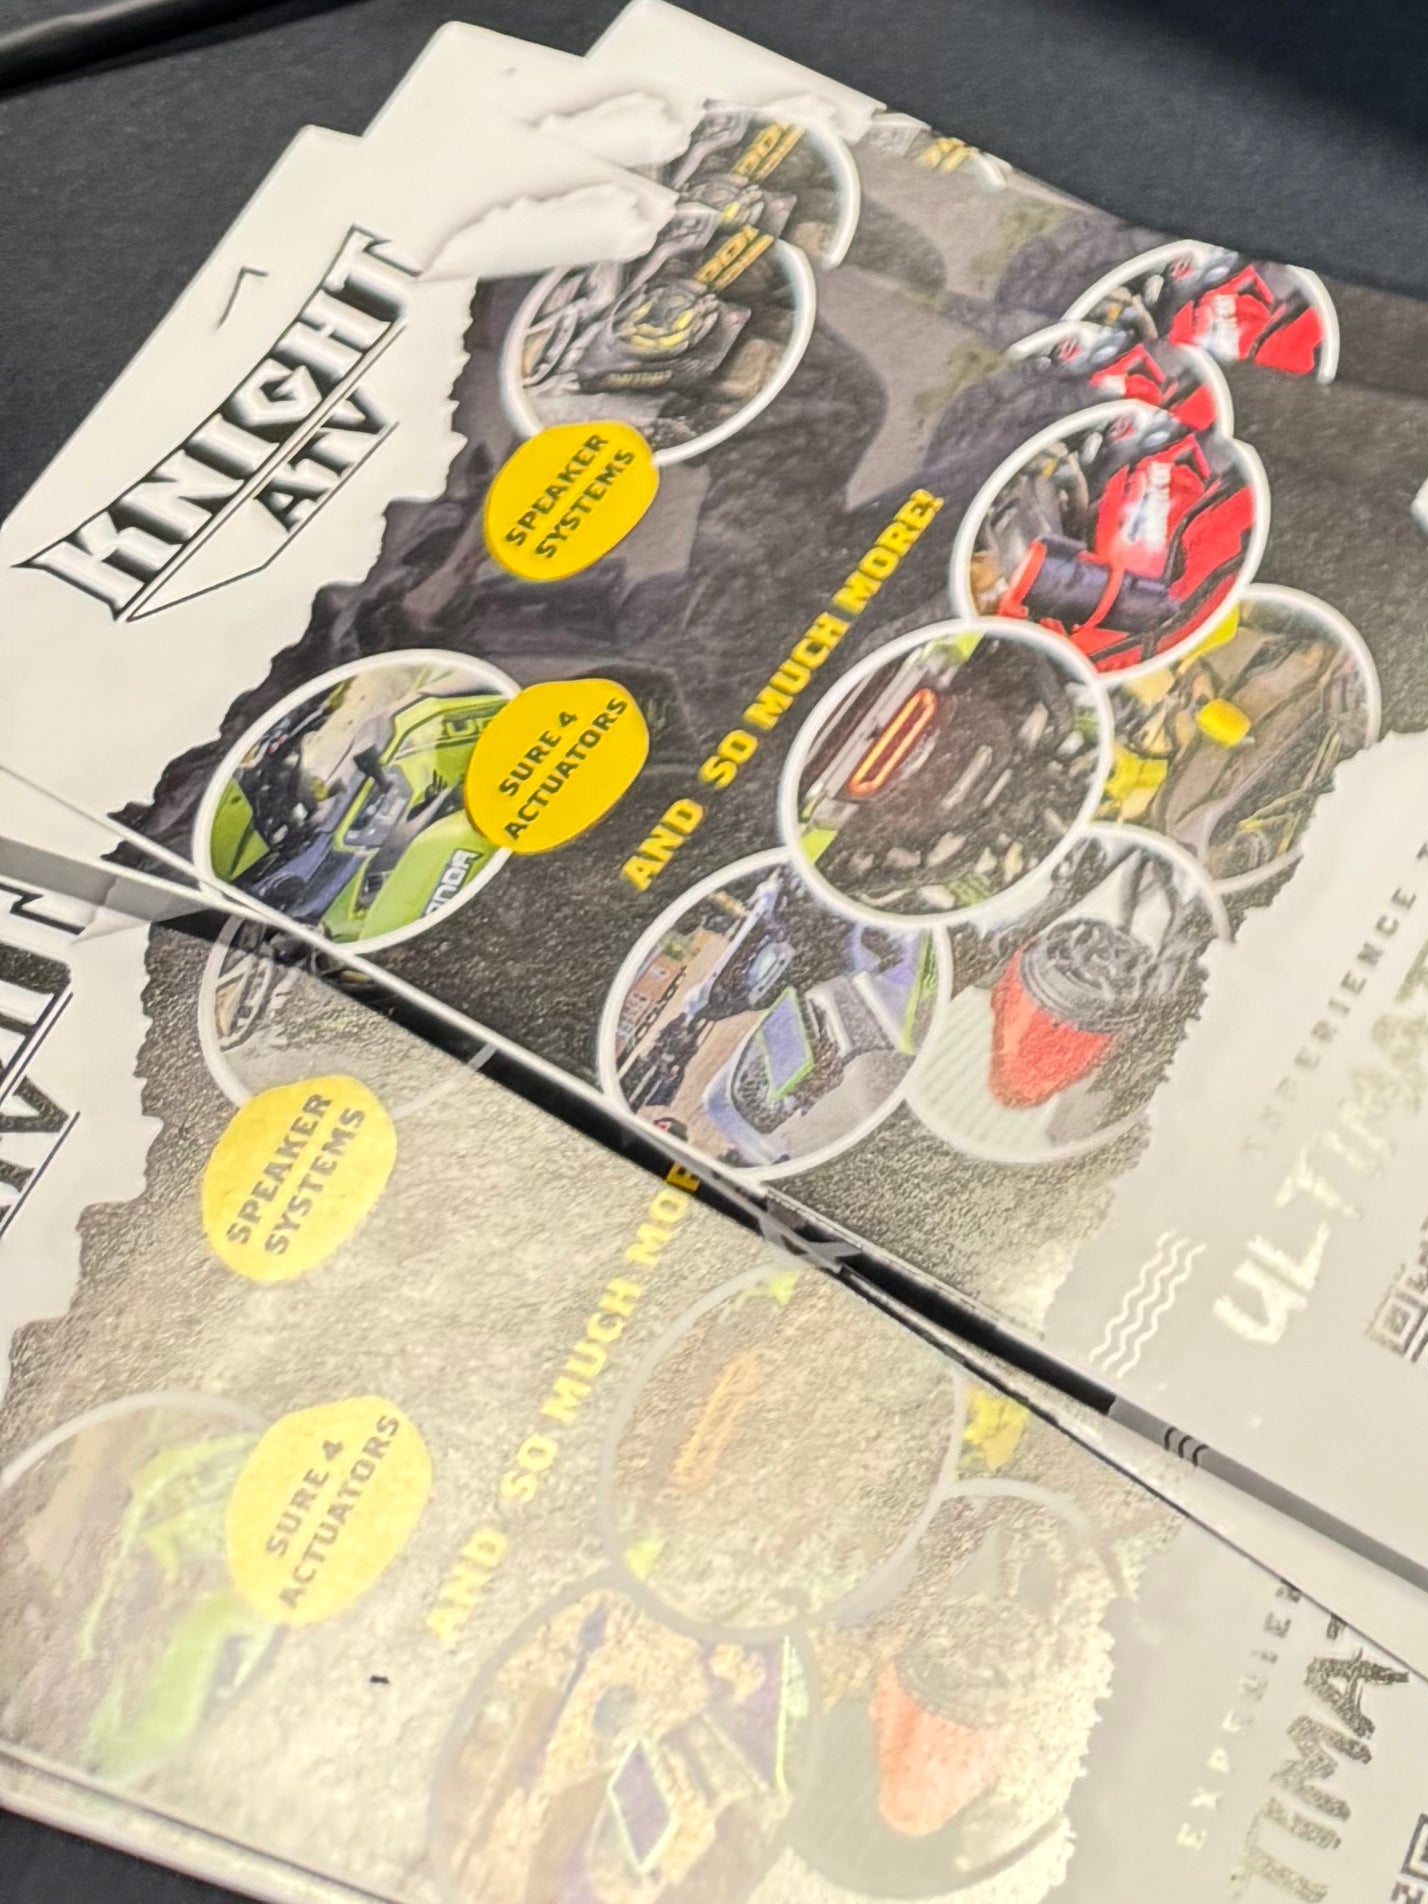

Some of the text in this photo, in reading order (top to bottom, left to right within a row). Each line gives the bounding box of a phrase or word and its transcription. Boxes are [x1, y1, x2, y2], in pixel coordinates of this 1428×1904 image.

[10, 224, 422, 622] KNIGHT
[253, 385, 390, 533] ATV
[505, 434, 609, 547] SPEAKER
[535, 447, 635, 560] SYSTEMS
[498, 710, 579, 797] SURE 4
[621, 488, 944, 892] AND SO MUCH MORE!
[503, 697, 629, 842] ACTUATORS
[226, 1093, 332, 1244] SPEAKER
[264, 1107, 365, 1255] SYSTEMS
[265, 1440, 343, 1557] SURE 4
[278, 1415, 400, 1609] ACTUATORS
[426, 1526, 508, 1644] AND
[501, 1433, 559, 1505] SO
[540, 1277, 642, 1425] MUCH
